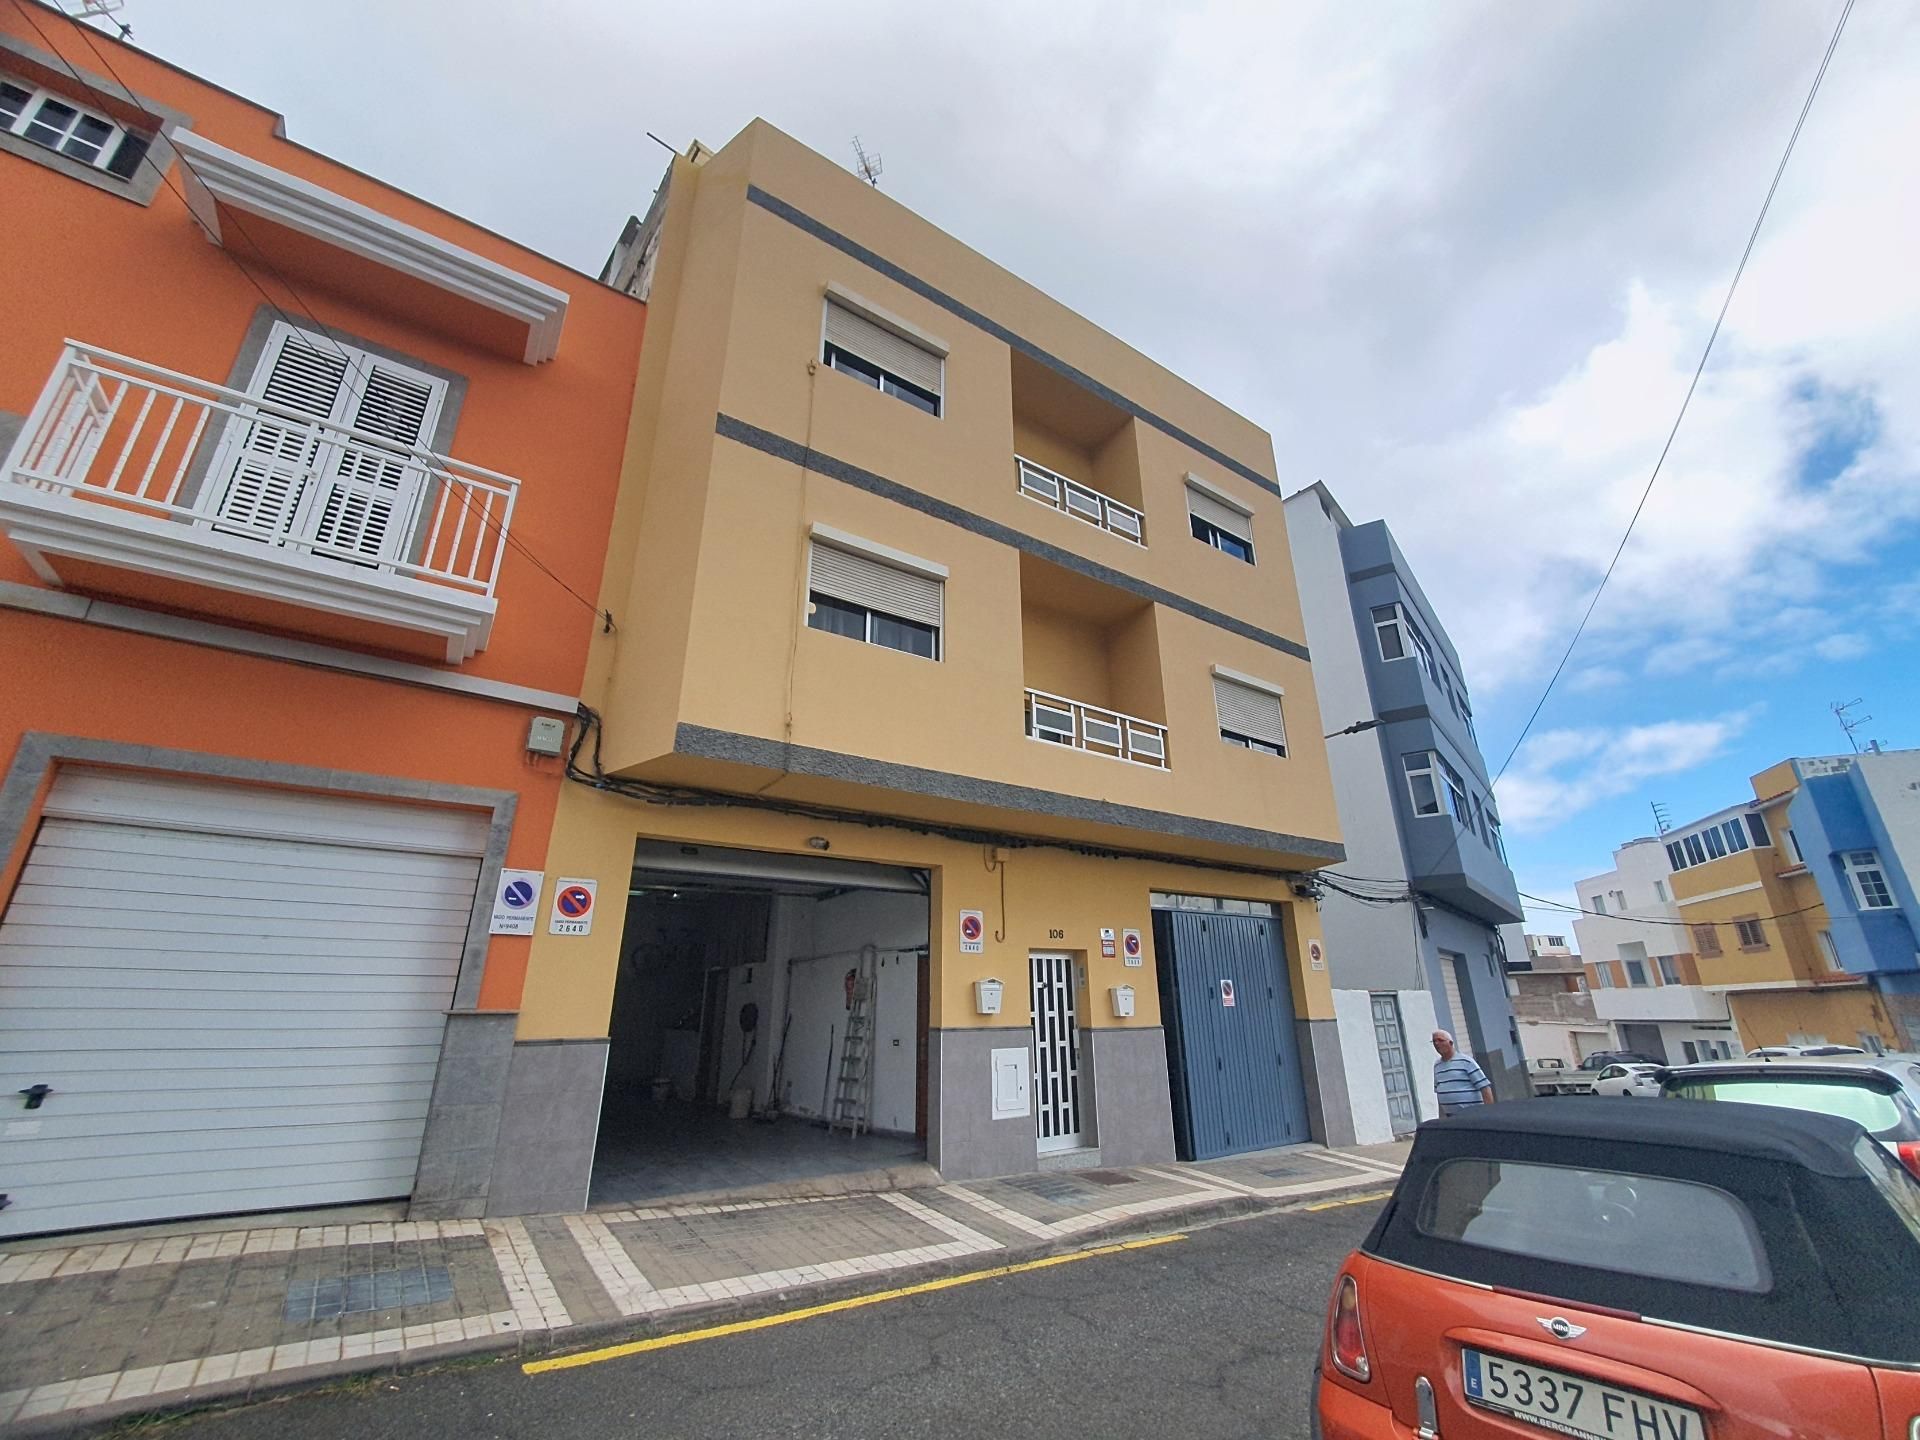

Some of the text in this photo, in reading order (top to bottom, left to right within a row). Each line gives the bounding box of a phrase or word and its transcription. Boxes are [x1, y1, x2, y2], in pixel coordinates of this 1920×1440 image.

[559, 924, 583, 932] 2640
[1049, 929, 1064, 939] 106
[1552, 1323, 1568, 1332] MINI
[1471, 1377, 1478, 1388] E
[1488, 1361, 1687, 1440] 5337 FHV
